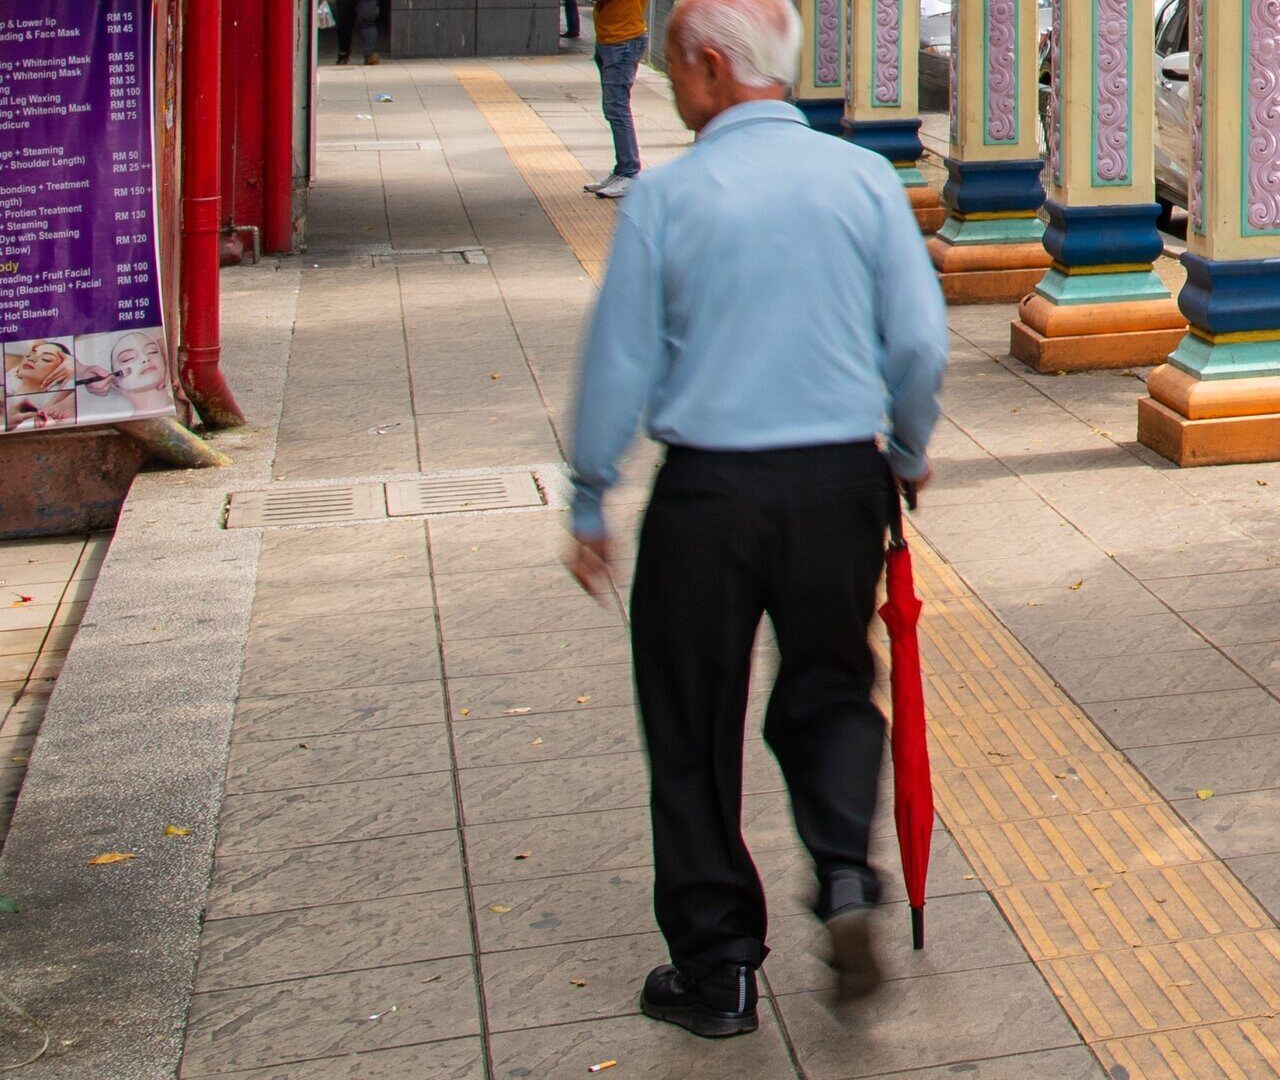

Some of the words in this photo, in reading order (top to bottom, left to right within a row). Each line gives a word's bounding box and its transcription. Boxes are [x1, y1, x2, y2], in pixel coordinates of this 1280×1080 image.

[8, 19, 14, 28] &
[17, 18, 43, 28] Lower
[45, 17, 57, 27] lip
[107, 13, 121, 22] RM
[123, 12, 133, 21] 15
[26, 30, 32, 39] &
[35, 29, 56, 39] Face
[57, 27, 80, 37] Mask
[107, 25, 121, 34] RM
[123, 24, 134, 33] 45
[22, 57, 67, 68] Whitening
[68, 55, 92, 65] Mask
[108, 52, 123, 62] RM
[124, 51, 135, 61] 55
[12, 70, 57, 81] Whitening
[59, 68, 82, 78] Mask
[109, 65, 123, 74] RM
[124, 64, 135, 73] 30
[109, 77, 123, 86] RM
[125, 75, 136, 85] 35
[110, 88, 124, 97] RM
[126, 87, 141, 96] 100
[10, 96, 27, 106] Leg
[29, 94, 61, 105] Waxing
[110, 100, 125, 109] RM
[126, 99, 137, 109] 85
[22, 105, 67, 116] Whitening
[68, 103, 92, 113] Mask
[111, 112, 125, 121] RM
[127, 111, 137, 120] 75
[22, 146, 64, 157] Steaming
[113, 152, 127, 161] RM
[128, 151, 139, 160] 50
[10, 159, 50, 170] Shoulder
[52, 155, 86, 168] Length)
[113, 164, 127, 173] RM
[129, 162, 139, 172] 25
[46, 179, 90, 191] Treatment
[114, 188, 128, 197] RM
[130, 186, 145, 196] 150
[5, 207, 37, 219] Protien
[39, 204, 82, 216] Treatment
[115, 212, 129, 221] RM
[131, 210, 146, 220] 130
[7, 220, 48, 231] Steaming
[18, 232, 37, 242] with
[38, 228, 80, 240] Steaming
[116, 235, 130, 245] RM
[132, 234, 147, 244] 120
[5, 245, 31, 256] Blow)
[117, 263, 131, 273] RM
[133, 262, 148, 272] 100
[42, 270, 63, 280] Fruit
[65, 267, 91, 278] Facial
[117, 275, 132, 285] RM
[134, 273, 149, 283] 100
[16, 282, 66, 296] (Bleaching)
[76, 278, 102, 289] Facial
[118, 300, 132, 309] RM
[135, 298, 150, 308] 150
[5, 311, 20, 321] Hot
[22, 307, 59, 319] Blanket)
[118, 312, 133, 321] RM
[134, 310, 145, 320] 85
